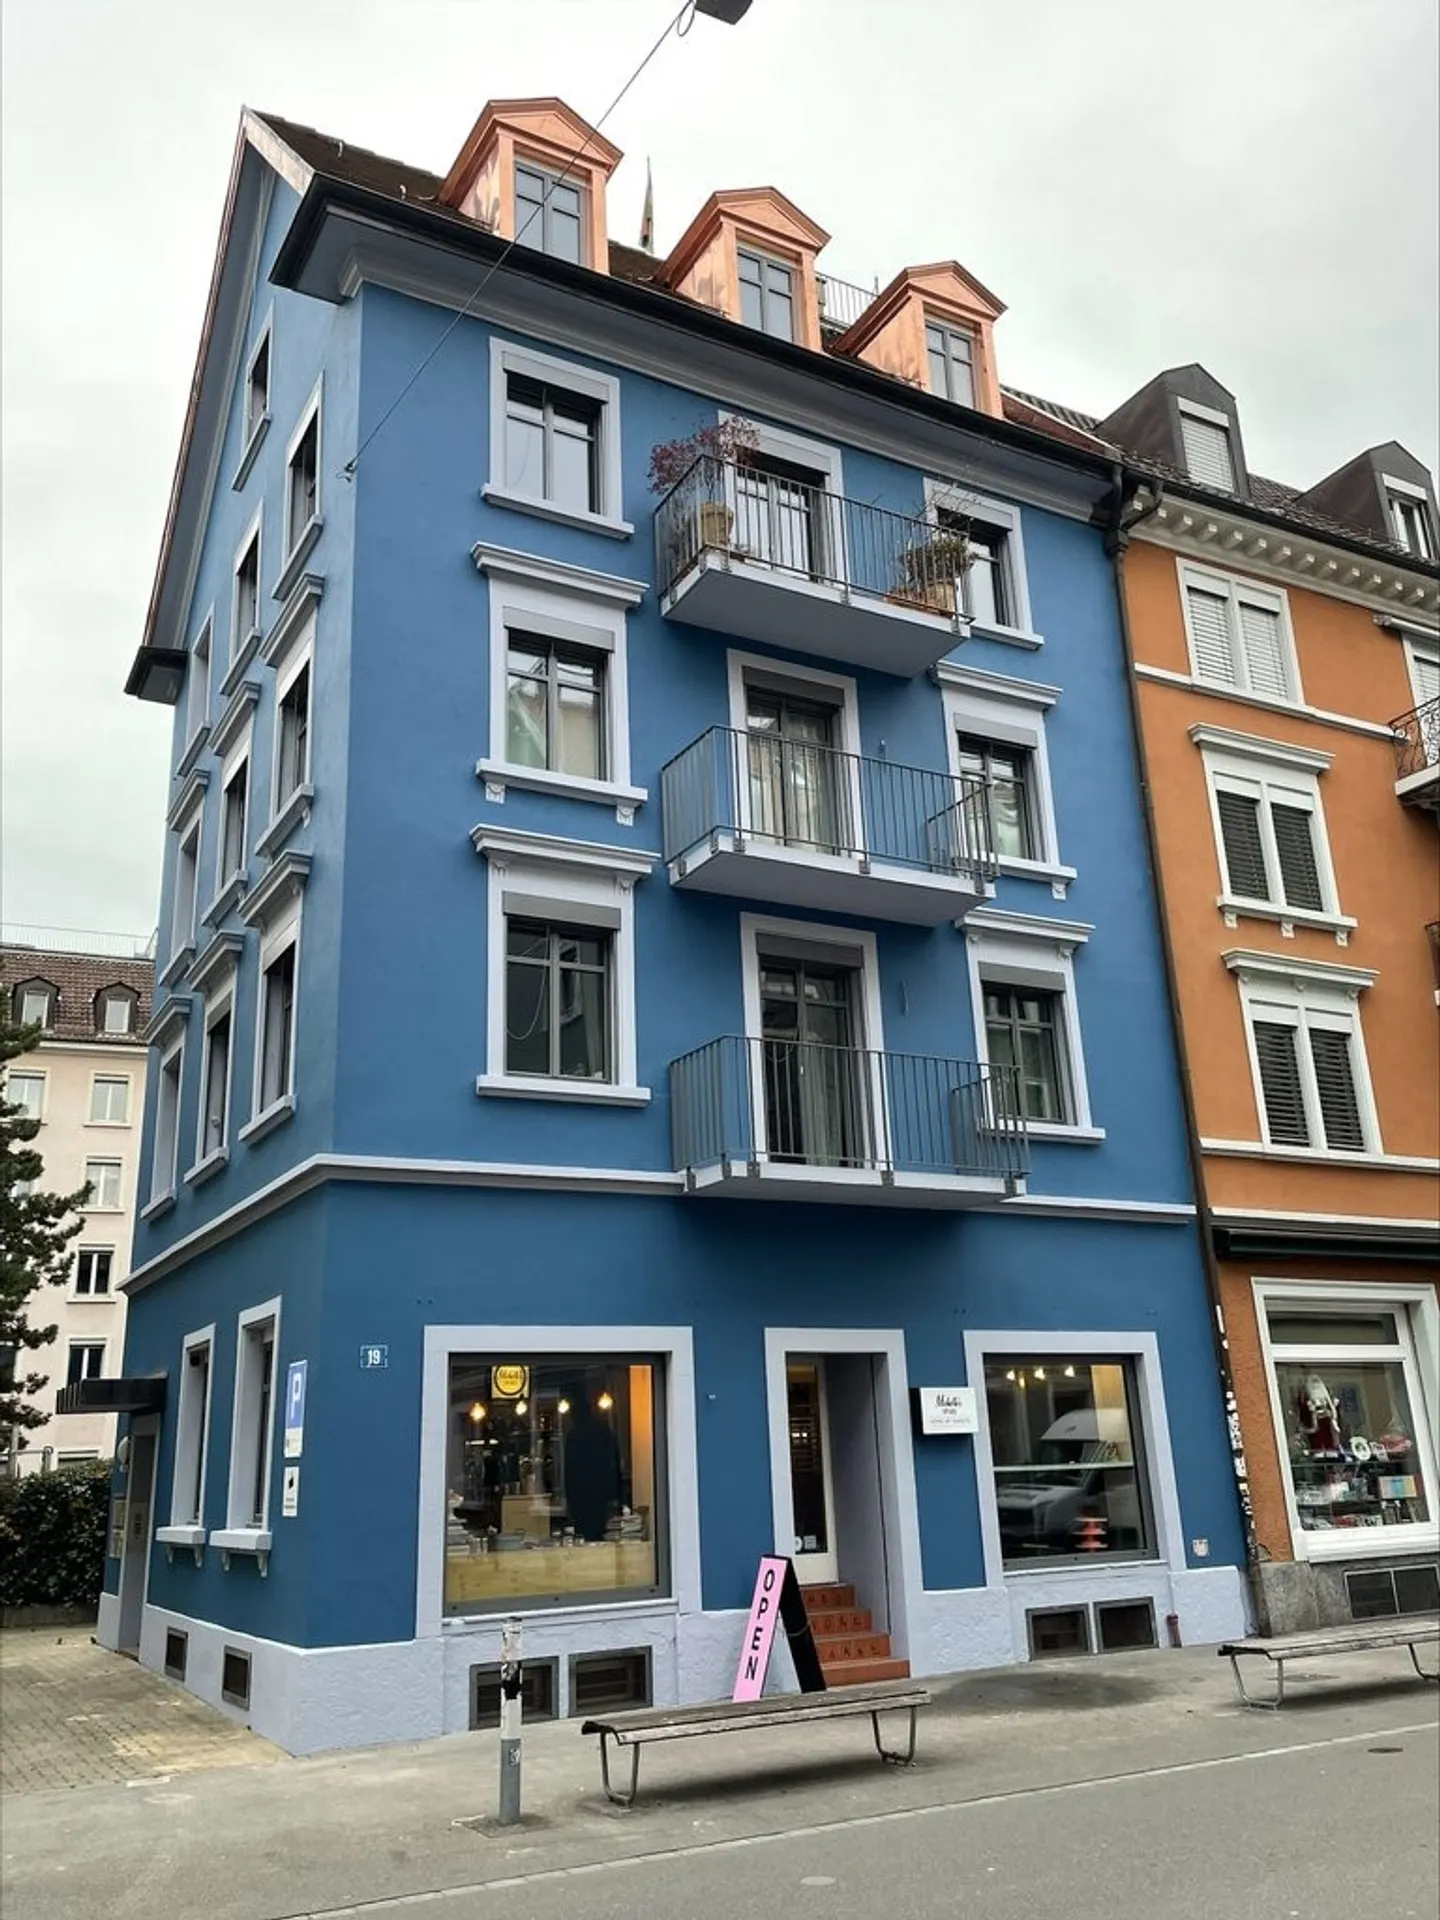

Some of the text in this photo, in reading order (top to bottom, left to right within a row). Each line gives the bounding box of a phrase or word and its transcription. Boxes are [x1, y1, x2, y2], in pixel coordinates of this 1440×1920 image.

[367, 1349, 380, 1364] 19
[290, 1372, 302, 1420] P
[744, 1569, 776, 1681] OPEN
